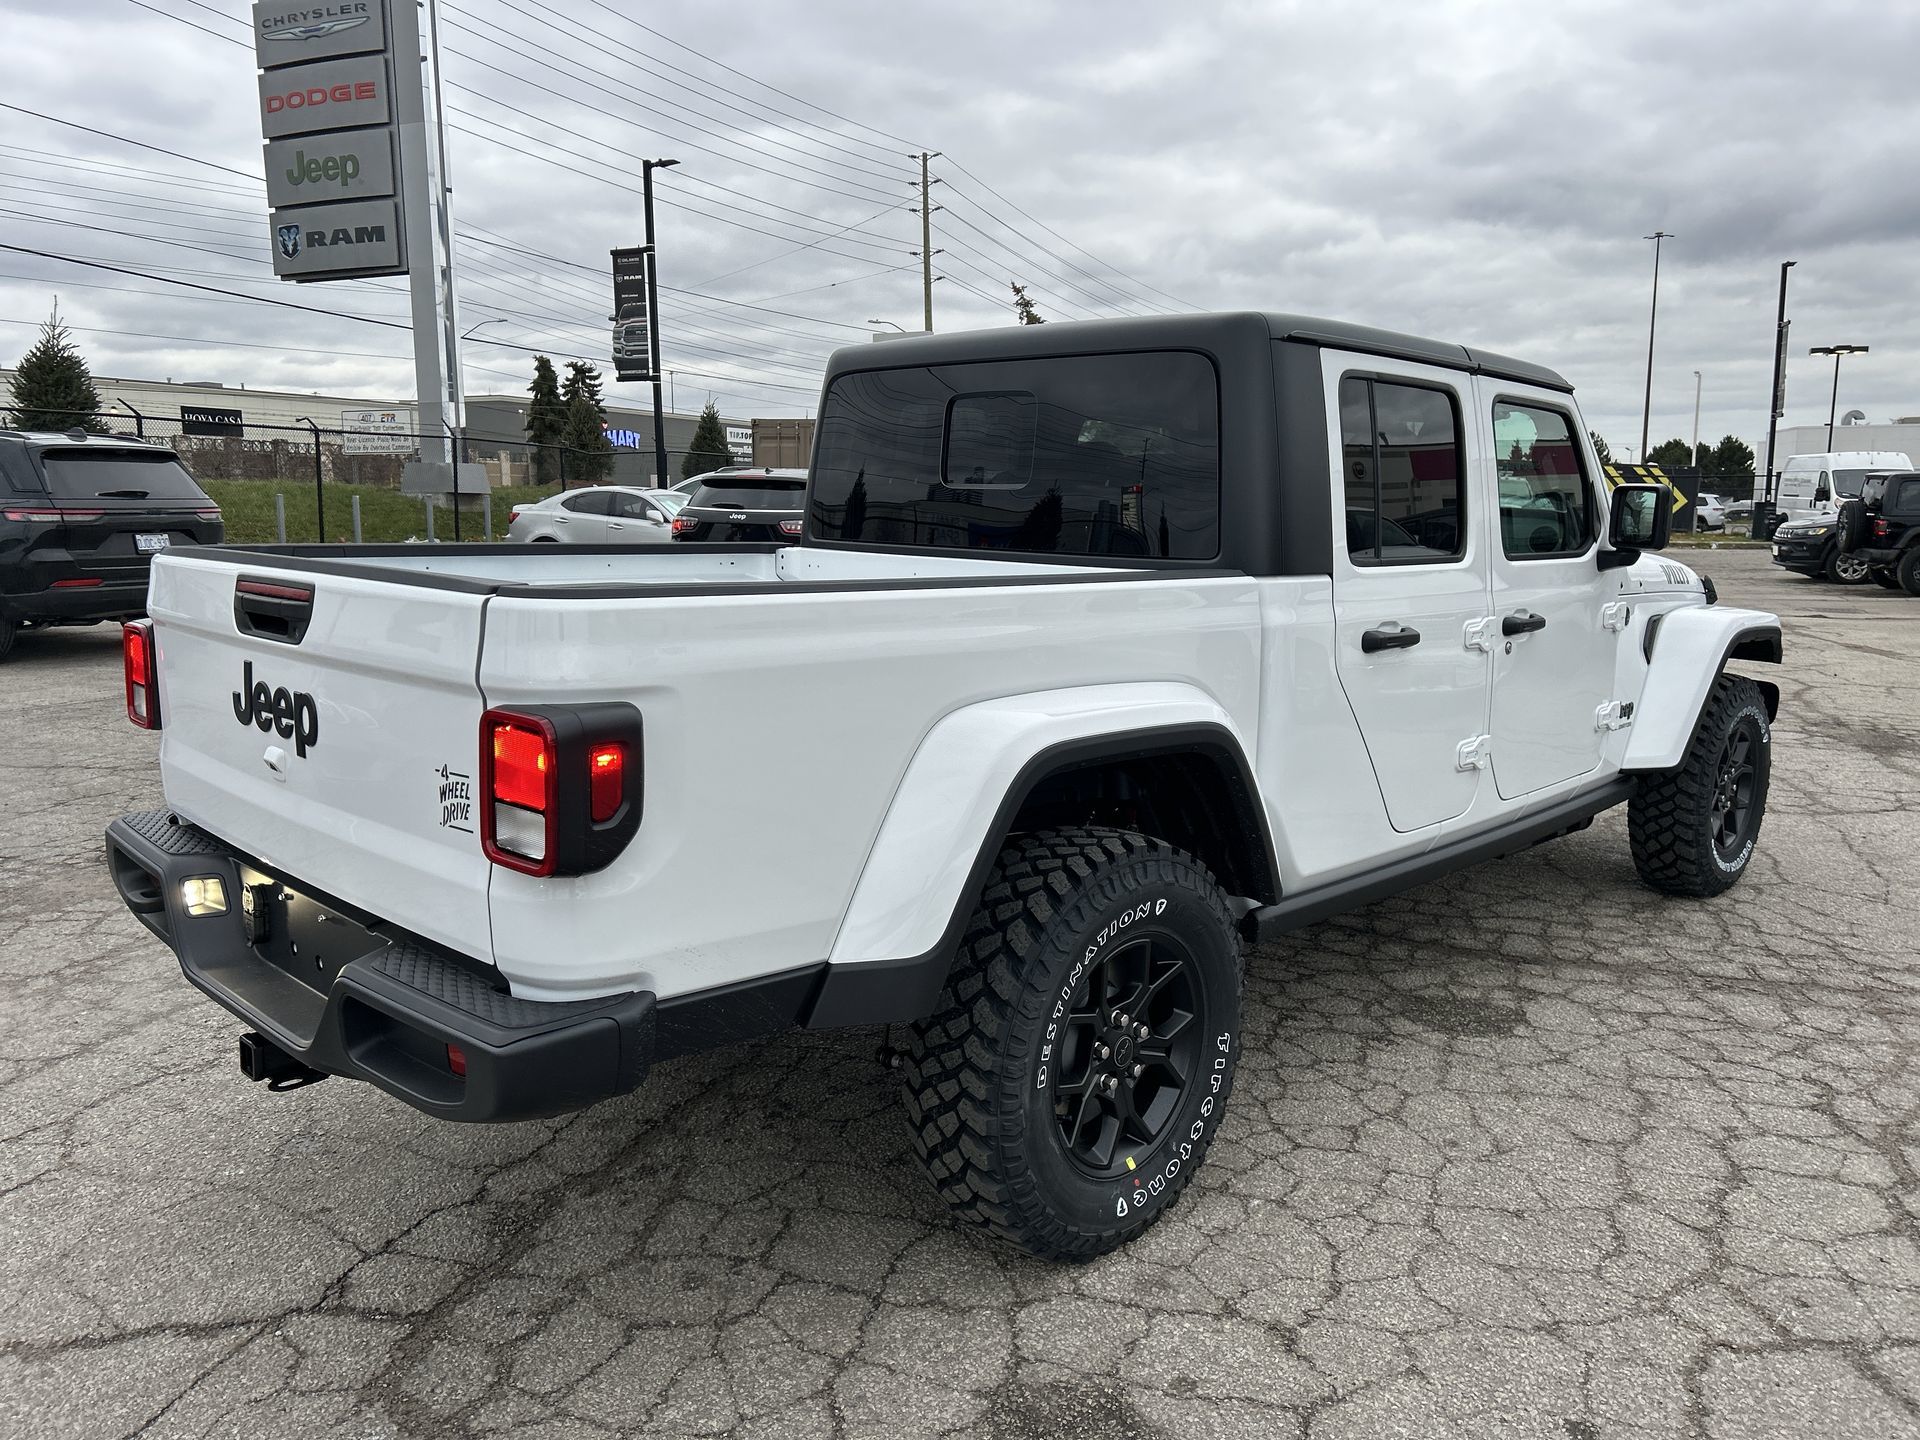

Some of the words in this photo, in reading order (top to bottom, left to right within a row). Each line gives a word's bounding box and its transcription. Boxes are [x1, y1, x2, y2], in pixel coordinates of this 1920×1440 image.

[261, 2, 368, 29] CHRYSLER
[266, 81, 376, 113] DODGE
[286, 150, 360, 186] Jeep
[305, 225, 386, 248] RAM
[184, 413, 213, 424] HOYA
[215, 415, 242, 424] CASA
[605, 430, 640, 449] MART
[729, 512, 747, 520] Jeep
[232, 660, 318, 759] Jeep
[441, 763, 449, 781] 4
[439, 781, 470, 803] WHEEL
[442, 802, 470, 827] DRIVE
[1036, 900, 1151, 1089] DESTINATION
